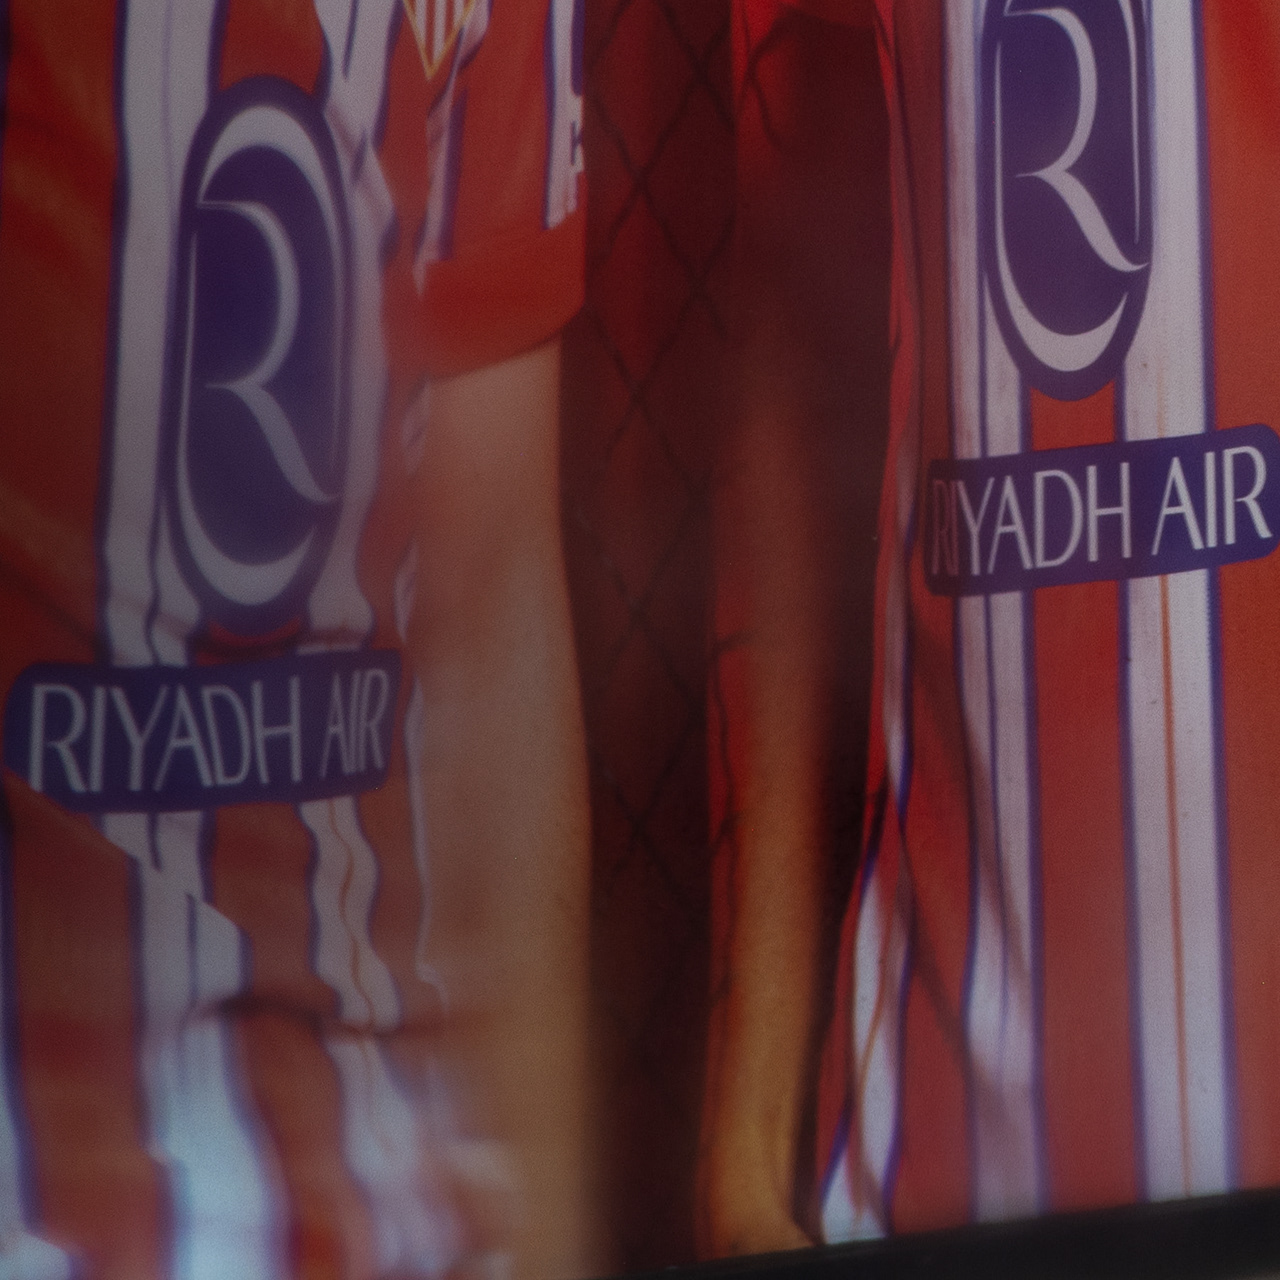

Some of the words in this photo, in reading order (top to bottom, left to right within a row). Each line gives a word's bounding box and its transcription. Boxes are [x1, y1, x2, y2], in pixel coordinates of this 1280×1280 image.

[931, 462, 1132, 576] RIYADH
[1151, 444, 1274, 556] AIR
[28, 675, 303, 794] RIYADH
[320, 667, 390, 778] AIR
